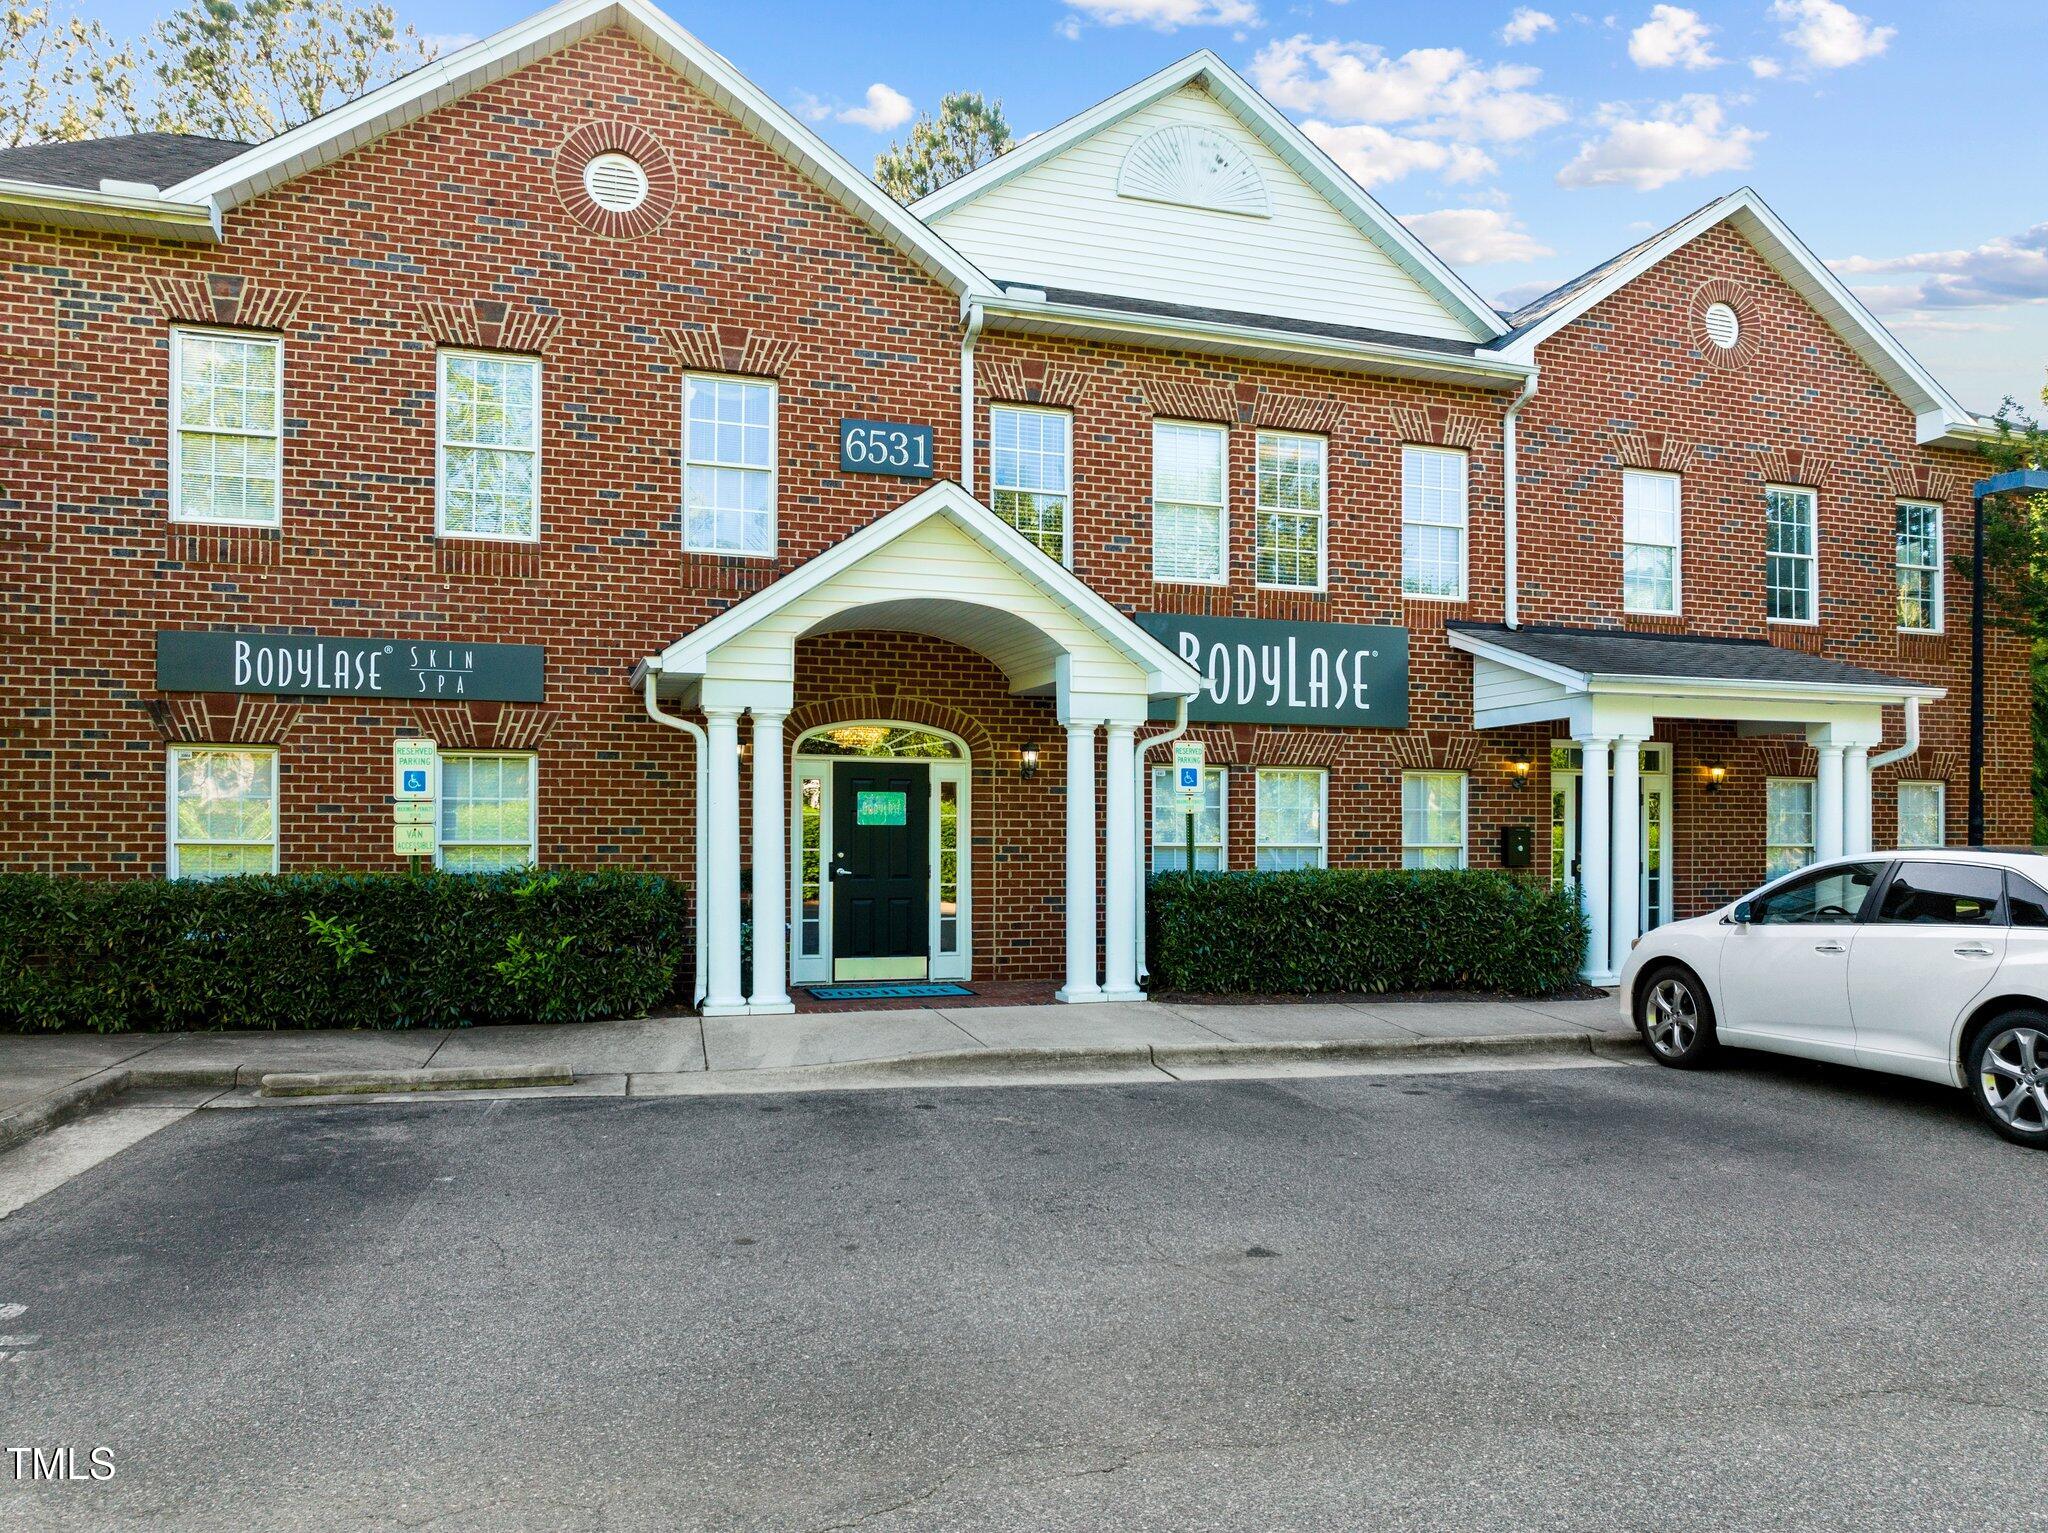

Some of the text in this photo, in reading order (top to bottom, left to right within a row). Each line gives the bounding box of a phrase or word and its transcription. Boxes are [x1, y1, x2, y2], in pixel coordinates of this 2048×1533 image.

[846, 428, 930, 468] 6531
[410, 646, 474, 669] SKIN
[418, 671, 464, 694] SPA
[396, 747, 433, 756] RESERVED
[1175, 747, 1203, 755] RESERVED
[399, 757, 431, 766] PARKING
[1177, 756, 1201, 764] PARKING
[406, 830, 424, 839] VAN
[397, 841, 433, 850] ACCESSIBLE
